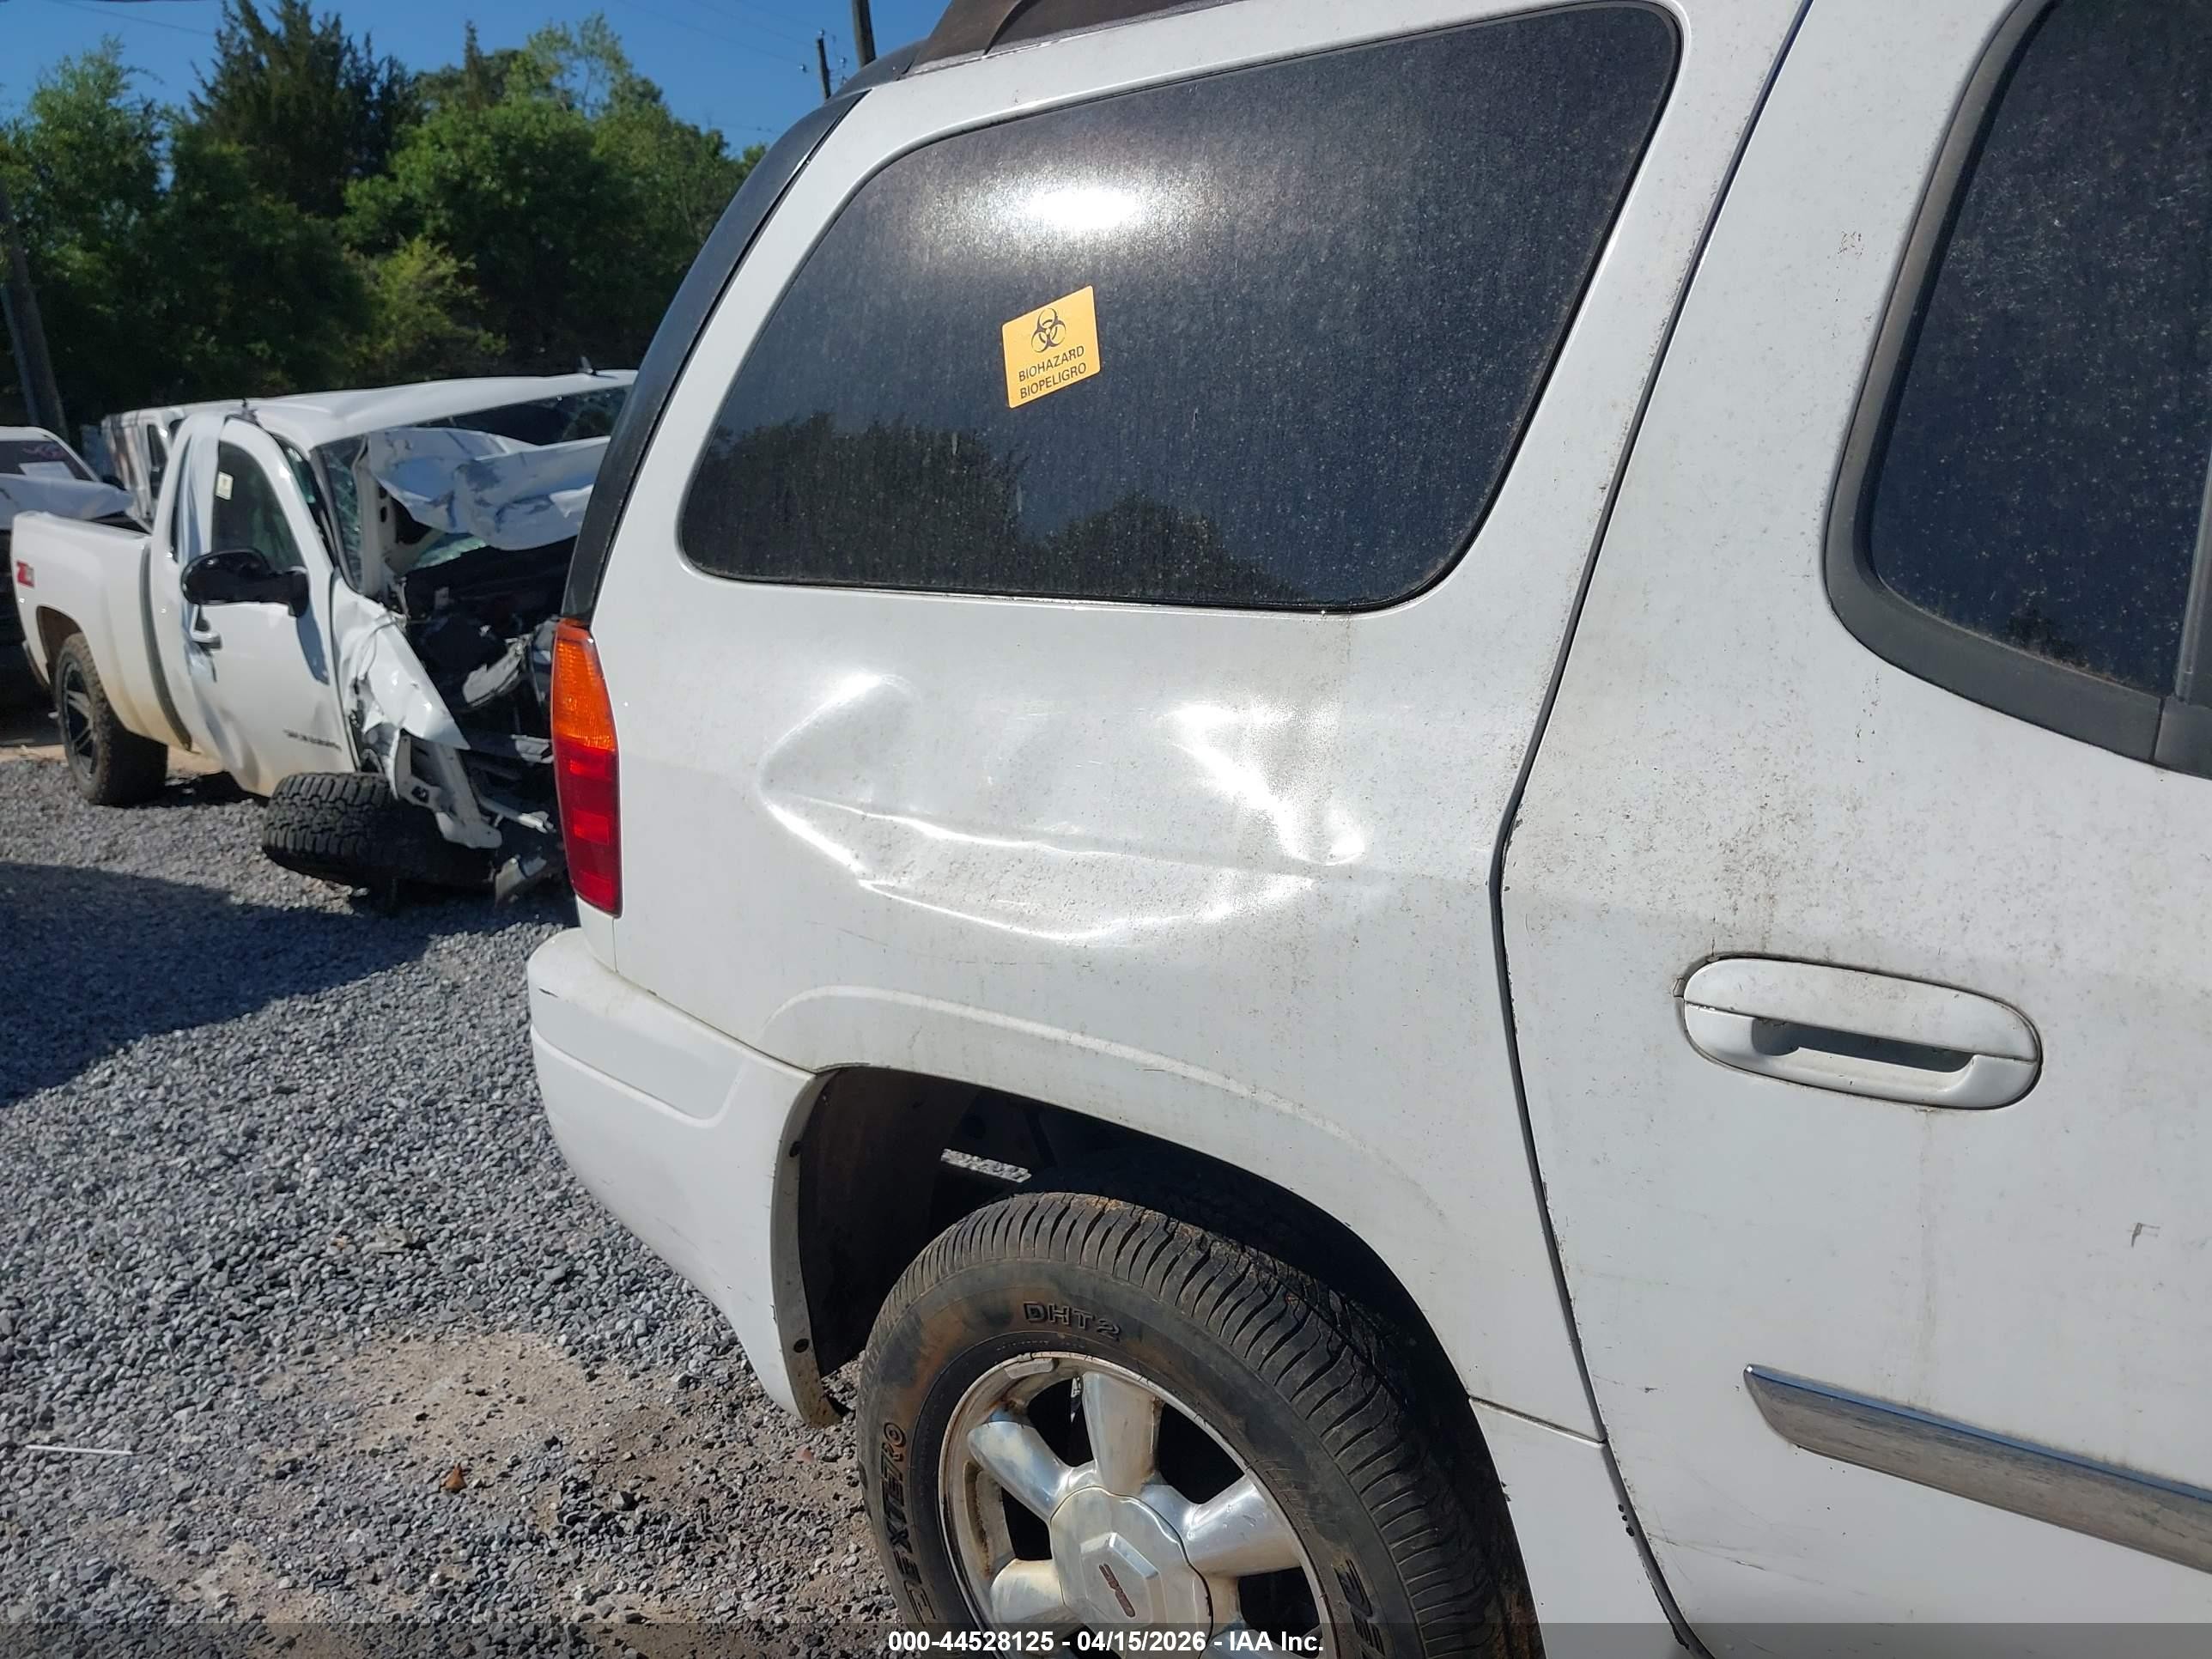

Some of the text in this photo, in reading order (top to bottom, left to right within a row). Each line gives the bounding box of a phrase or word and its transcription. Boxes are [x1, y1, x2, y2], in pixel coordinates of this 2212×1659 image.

[1018, 345, 1085, 382] BIOHAZARD
[1020, 362, 1087, 399] BIOPELIGRO
[1023, 1301, 1121, 1341] DHT2
